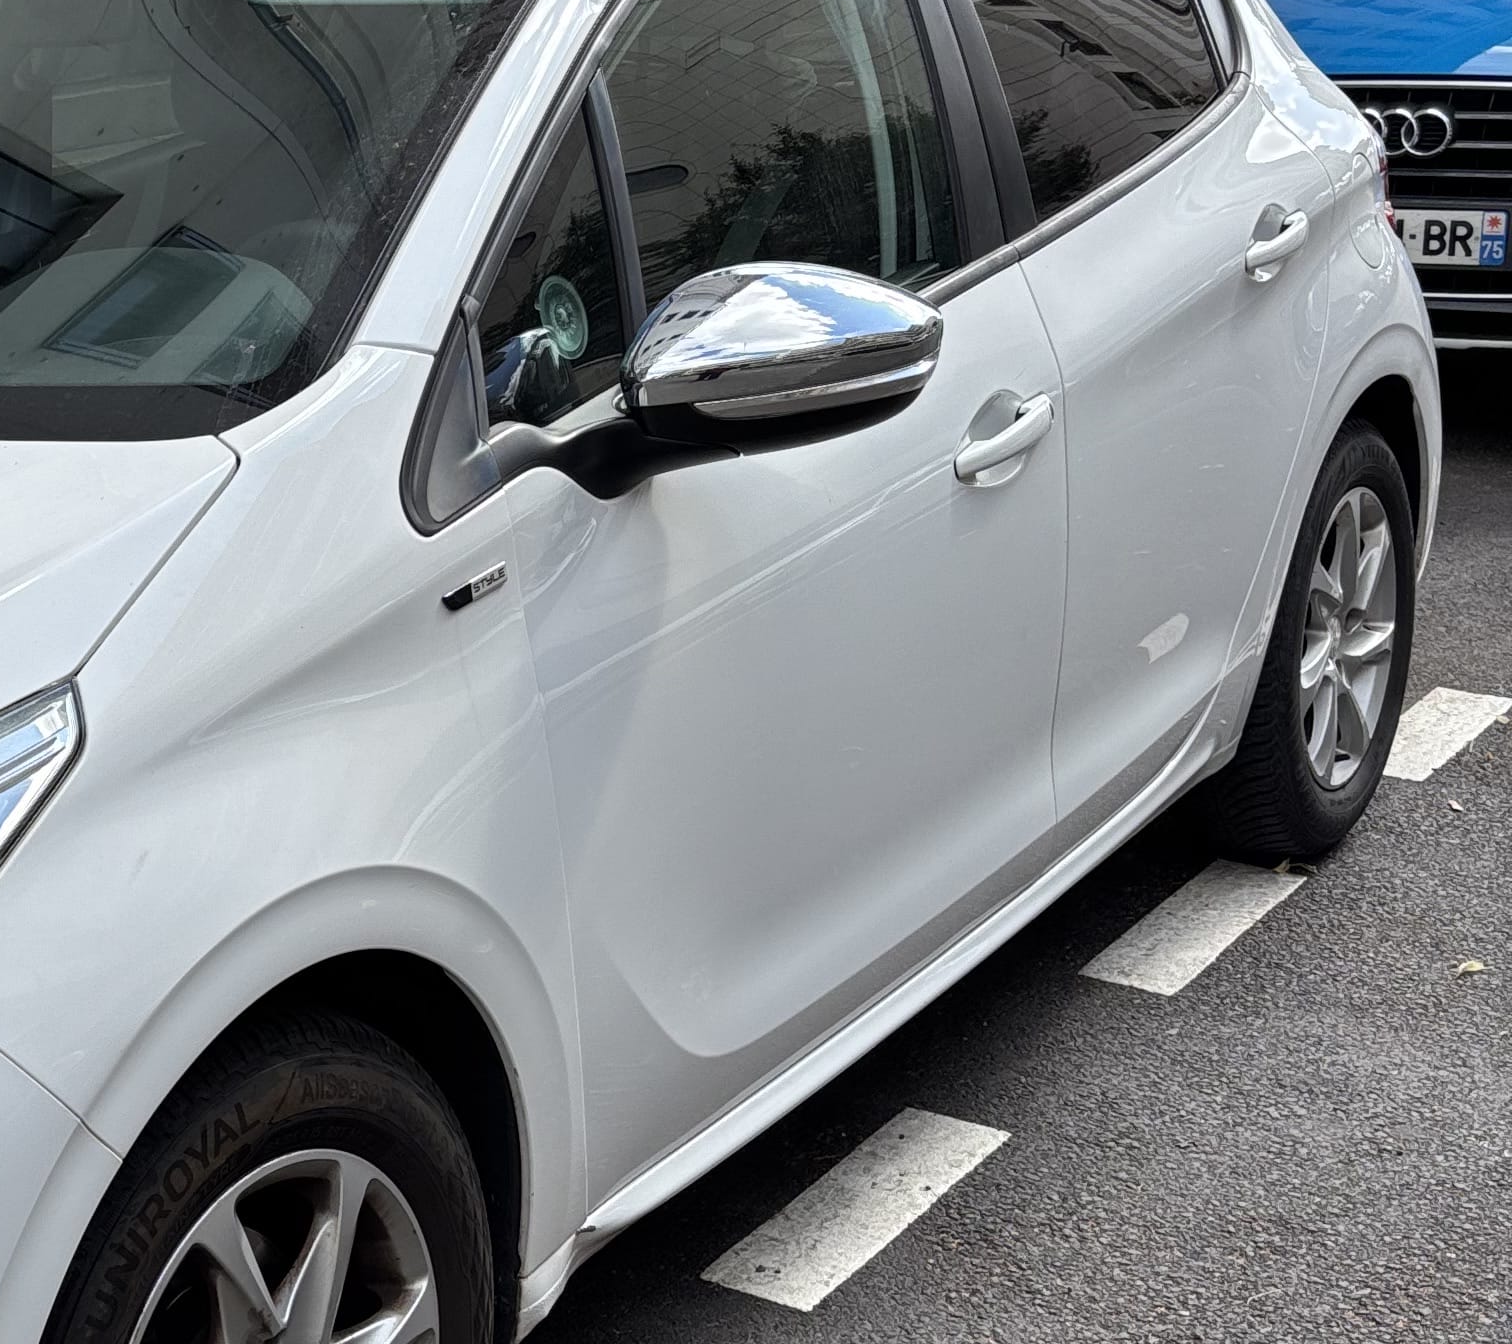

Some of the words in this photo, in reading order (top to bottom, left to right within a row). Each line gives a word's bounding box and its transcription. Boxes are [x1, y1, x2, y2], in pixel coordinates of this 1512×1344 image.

[1481, 240, 1504, 259] 75
[473, 566, 506, 594] STYLE
[84, 1099, 264, 1333] UNIROYAL
